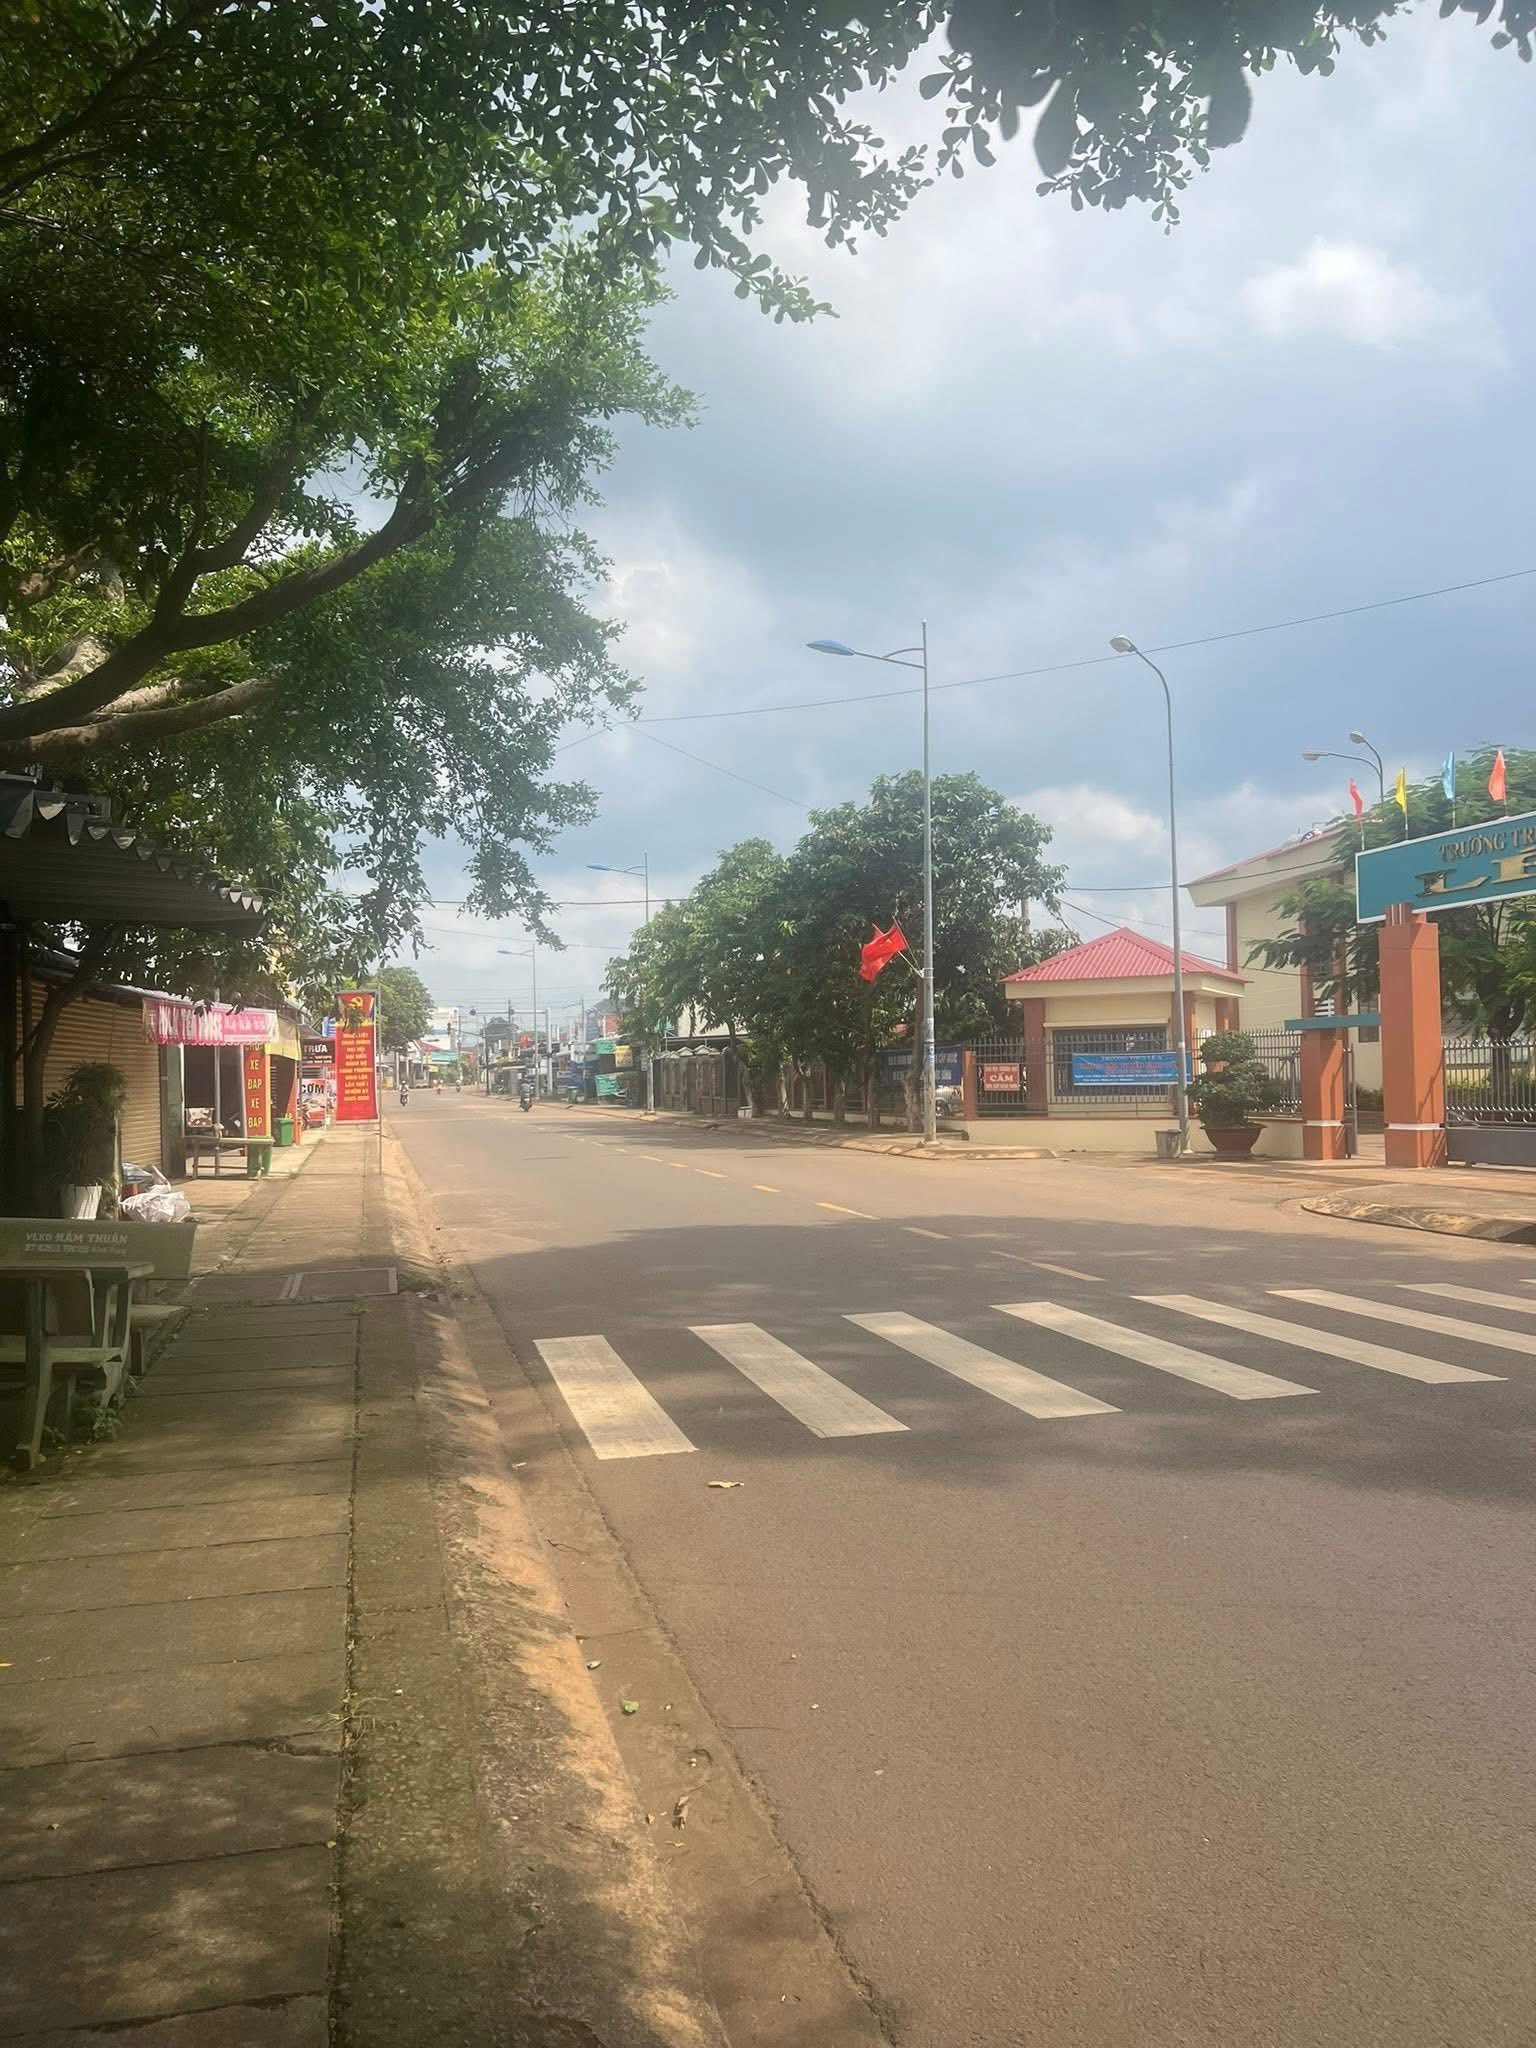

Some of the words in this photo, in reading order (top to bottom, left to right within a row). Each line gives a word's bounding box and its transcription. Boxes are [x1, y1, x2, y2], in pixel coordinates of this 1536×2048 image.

[250, 1060, 259, 1070] XE
[302, 1083, 324, 1095] CƠM
[250, 1098, 259, 1108] XE
